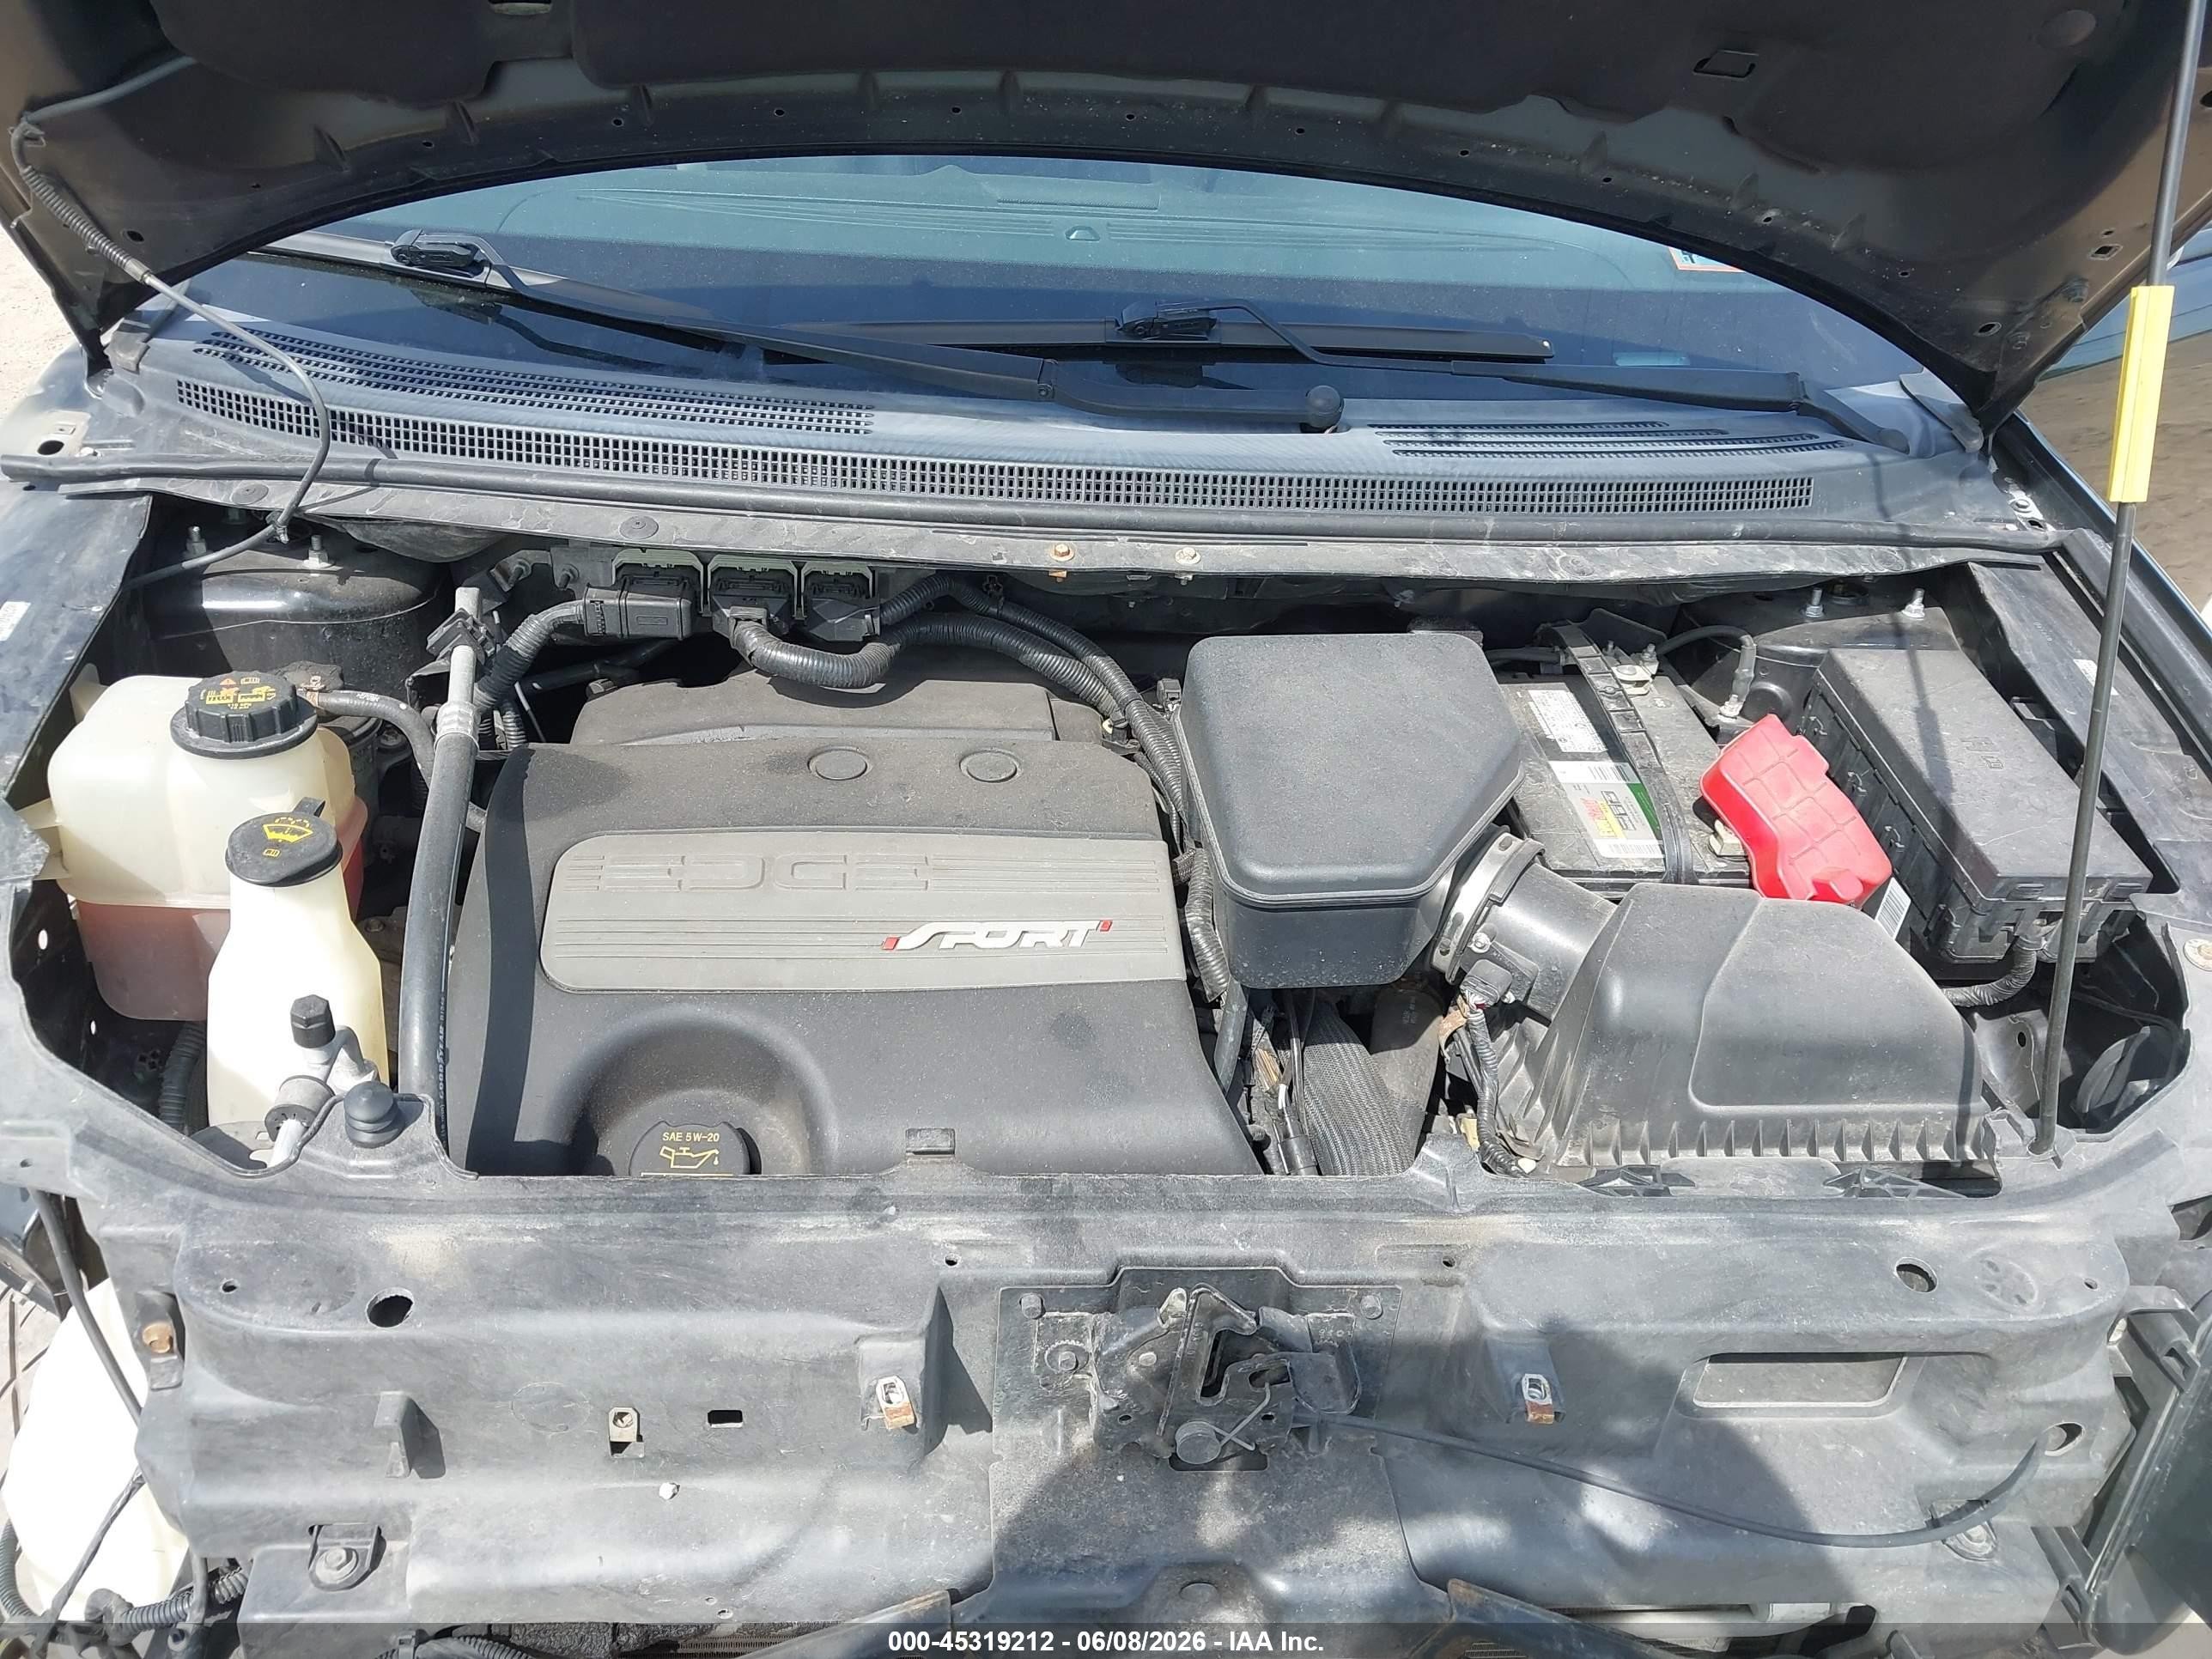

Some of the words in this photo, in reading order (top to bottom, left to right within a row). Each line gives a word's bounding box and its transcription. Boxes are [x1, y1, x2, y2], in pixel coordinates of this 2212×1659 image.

[604, 854, 929, 891] EDGE
[883, 920, 1112, 951] SPORT
[662, 1132, 683, 1141] SAE
[685, 1132, 720, 1142] 5W-20
